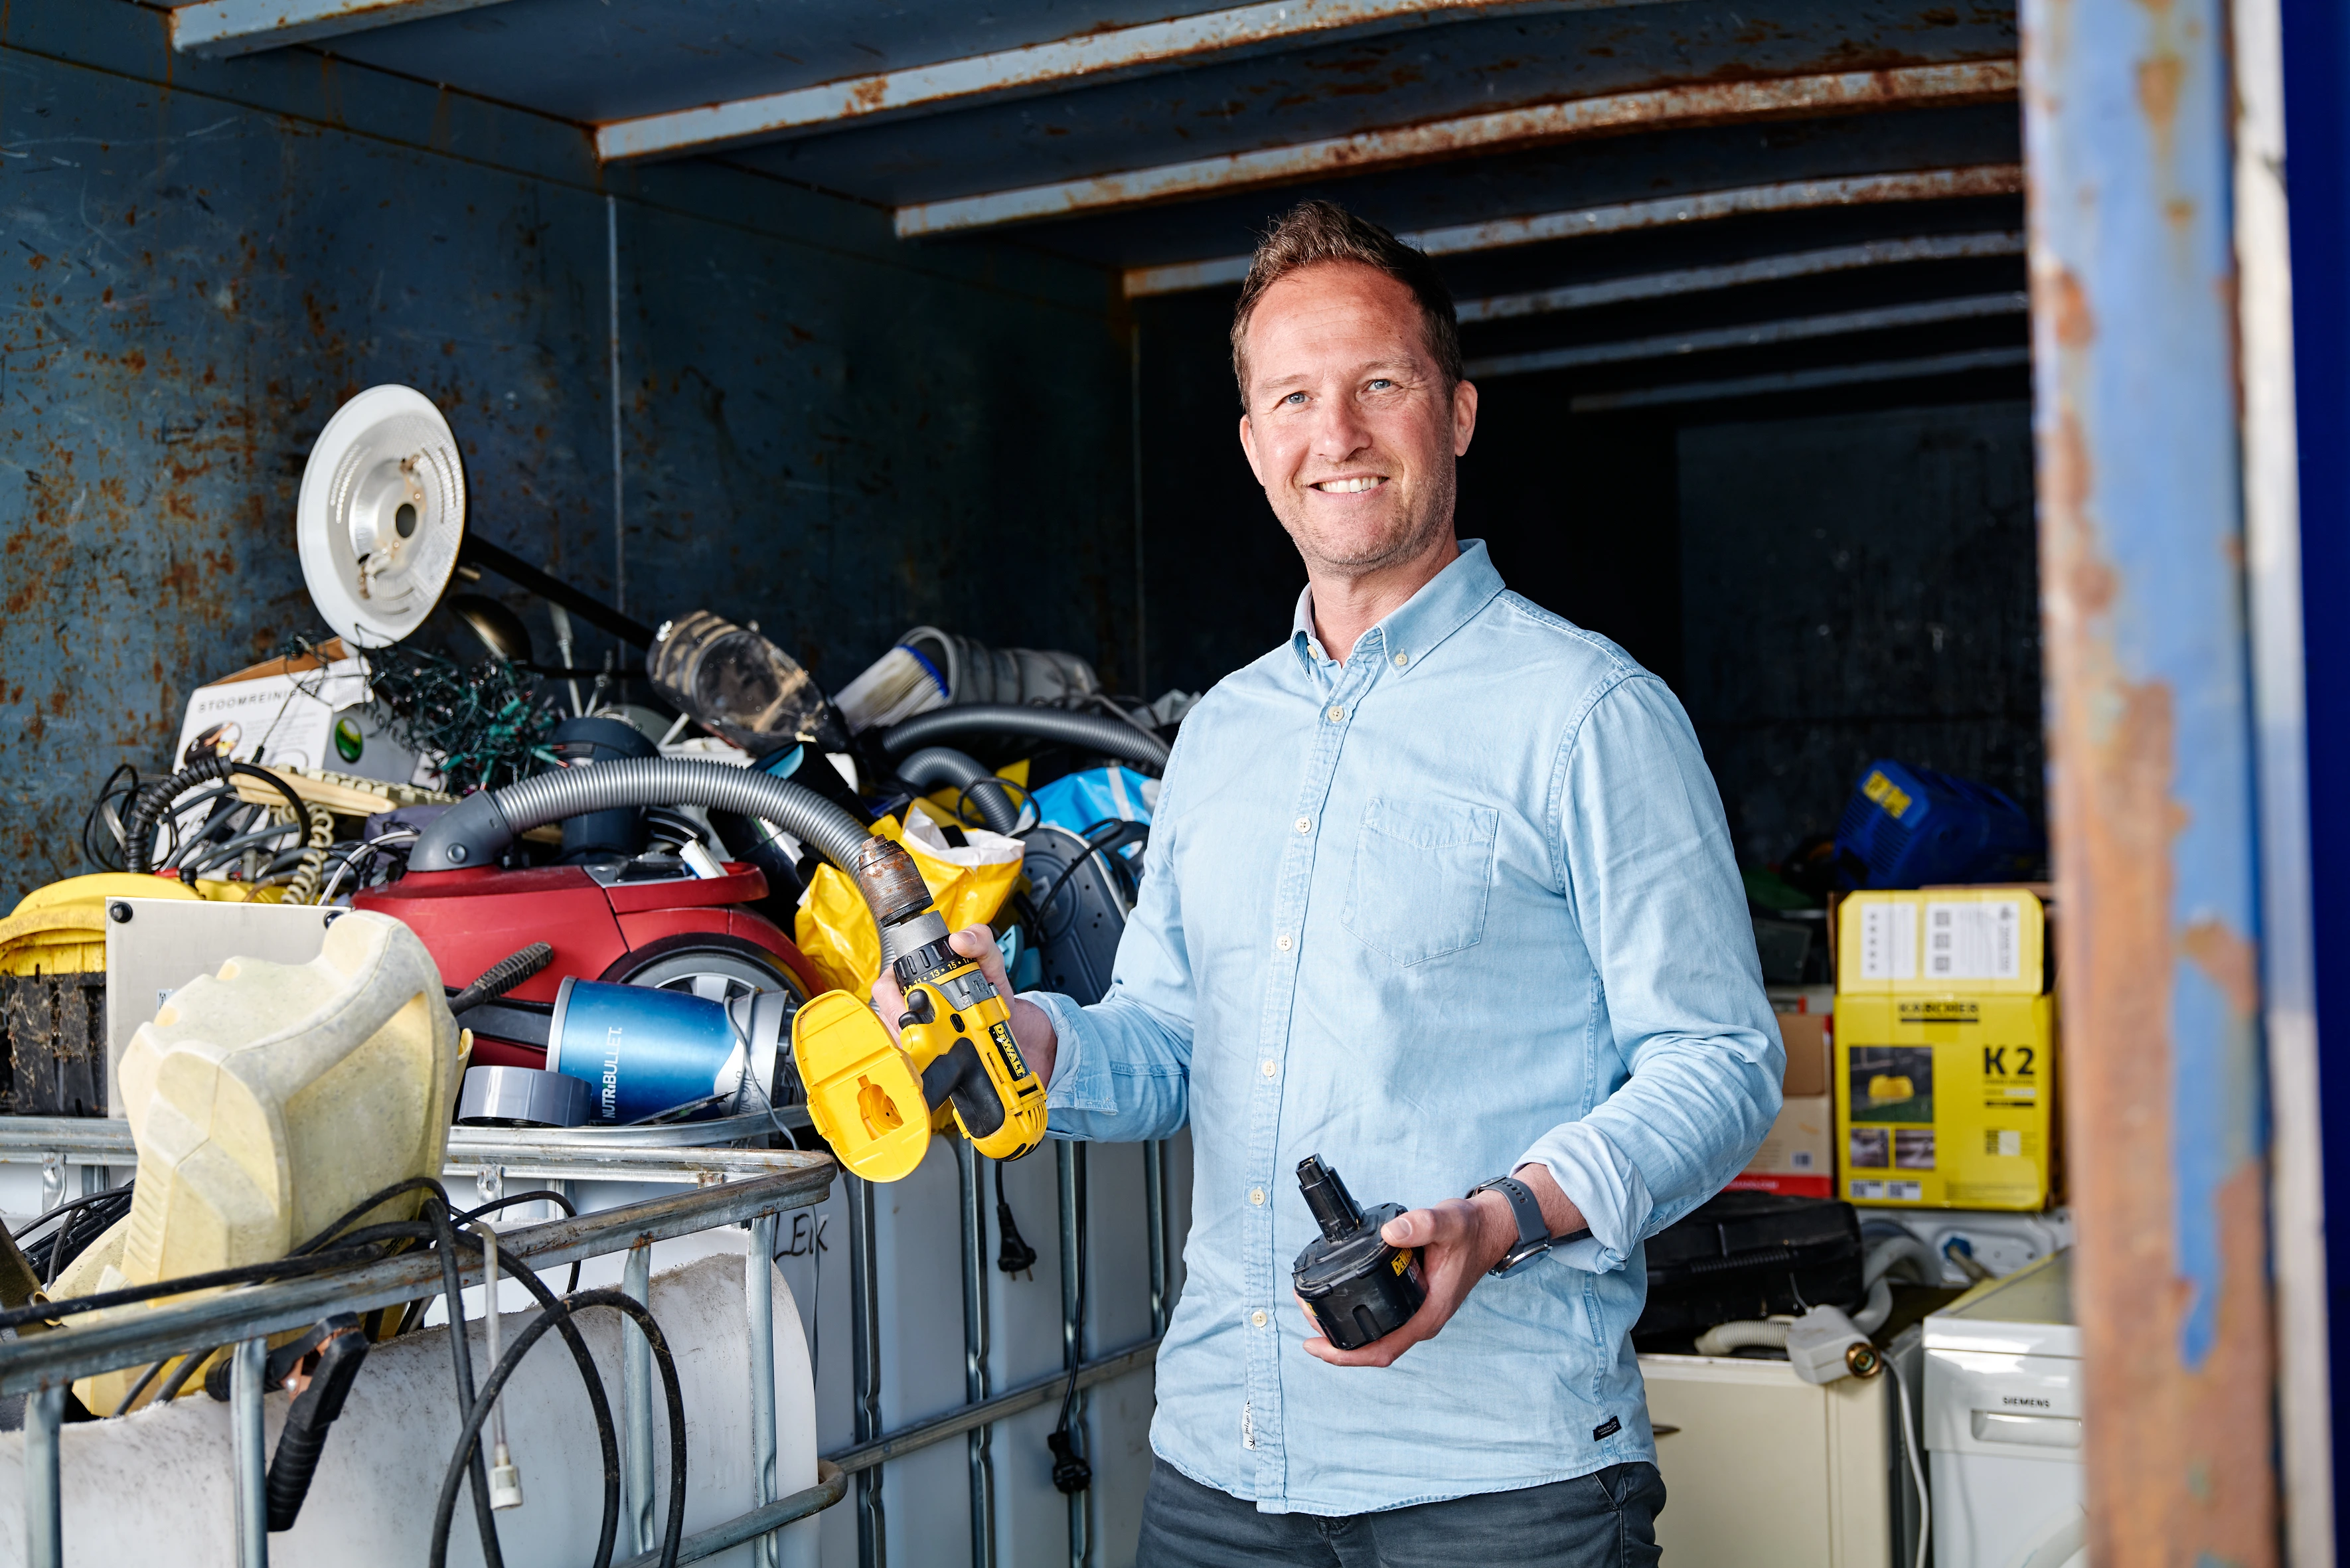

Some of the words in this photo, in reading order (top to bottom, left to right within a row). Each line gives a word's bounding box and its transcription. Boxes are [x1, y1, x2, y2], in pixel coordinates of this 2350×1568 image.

[930, 969, 941, 979] 13
[947, 961, 957, 970] 15
[994, 1024, 1026, 1076] DEWALT
[1985, 1046, 2005, 1075] K
[2017, 1047, 2035, 1075] 2
[2003, 1396, 2051, 1408] SIEMENS
